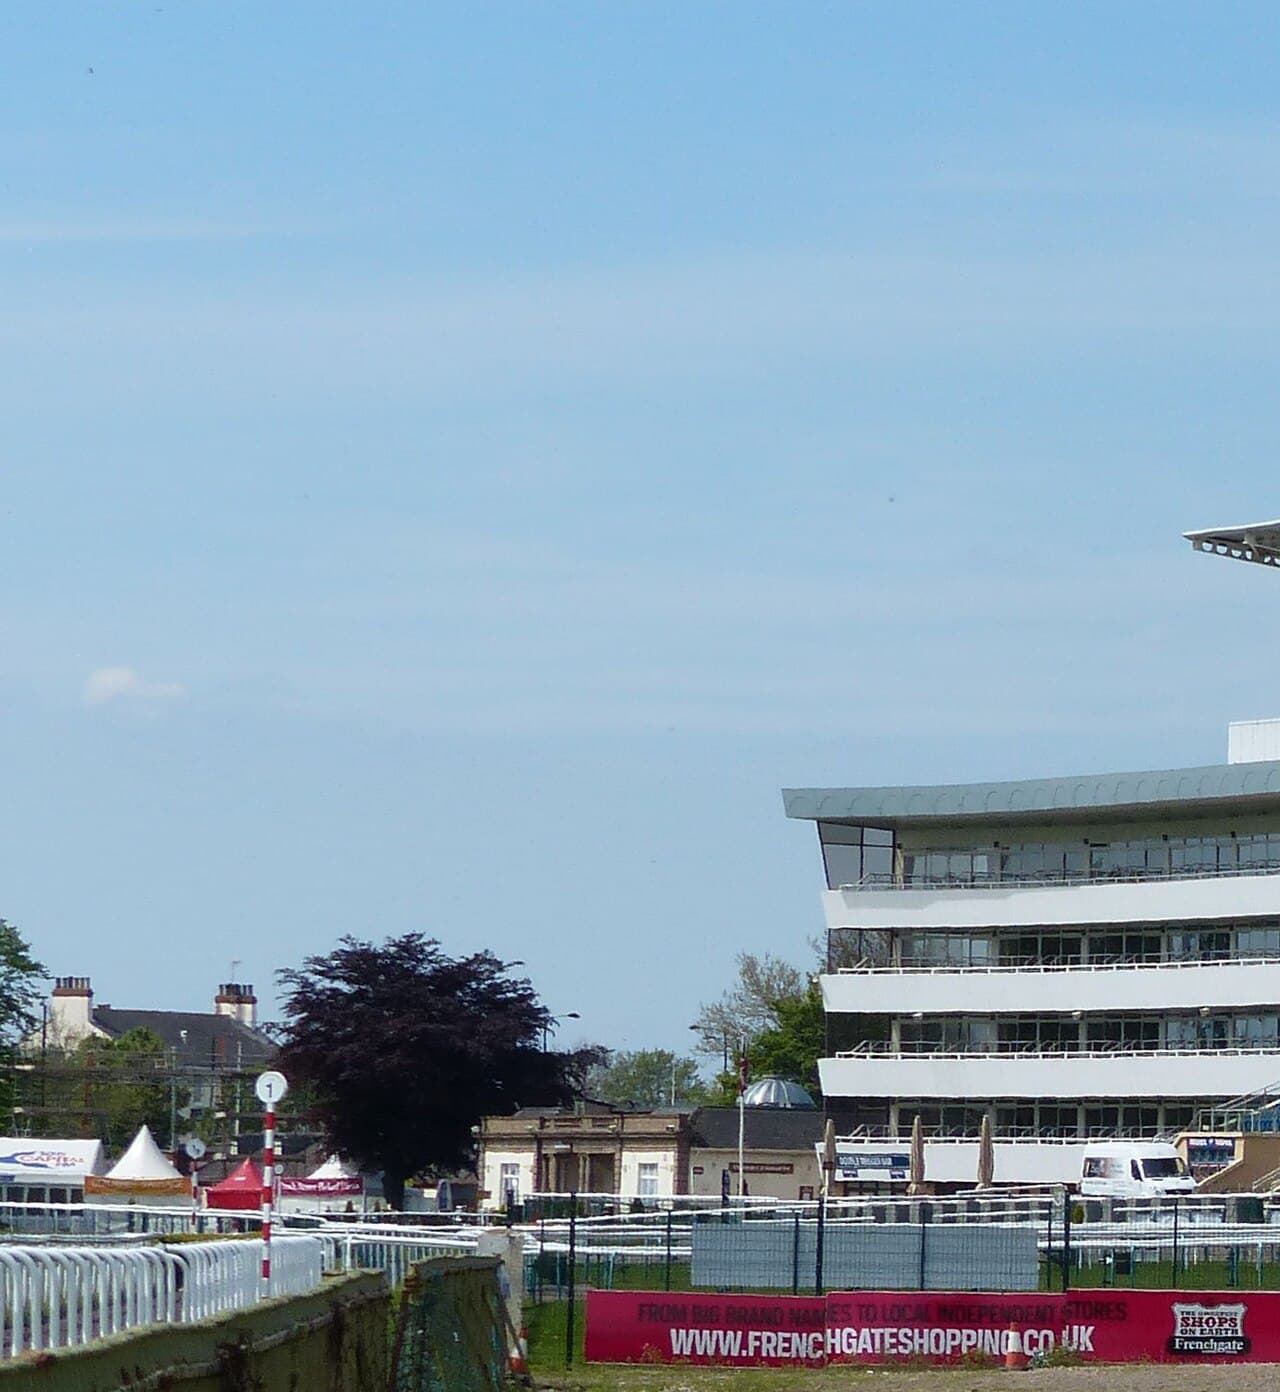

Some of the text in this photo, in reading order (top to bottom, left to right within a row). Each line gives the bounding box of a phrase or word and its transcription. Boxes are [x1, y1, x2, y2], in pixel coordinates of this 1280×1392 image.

[265, 1082, 273, 1098] 1
[637, 1301, 1128, 1326] FROM BIG BRAND NAMES TO LOCAL INDEPENDENT STORES
[1181, 1316, 1238, 1328] SHOPS
[670, 1325, 1095, 1359] WWW.FRENCHGATESHOPPINCOUK
[1174, 1338, 1244, 1353] Frenchgate
